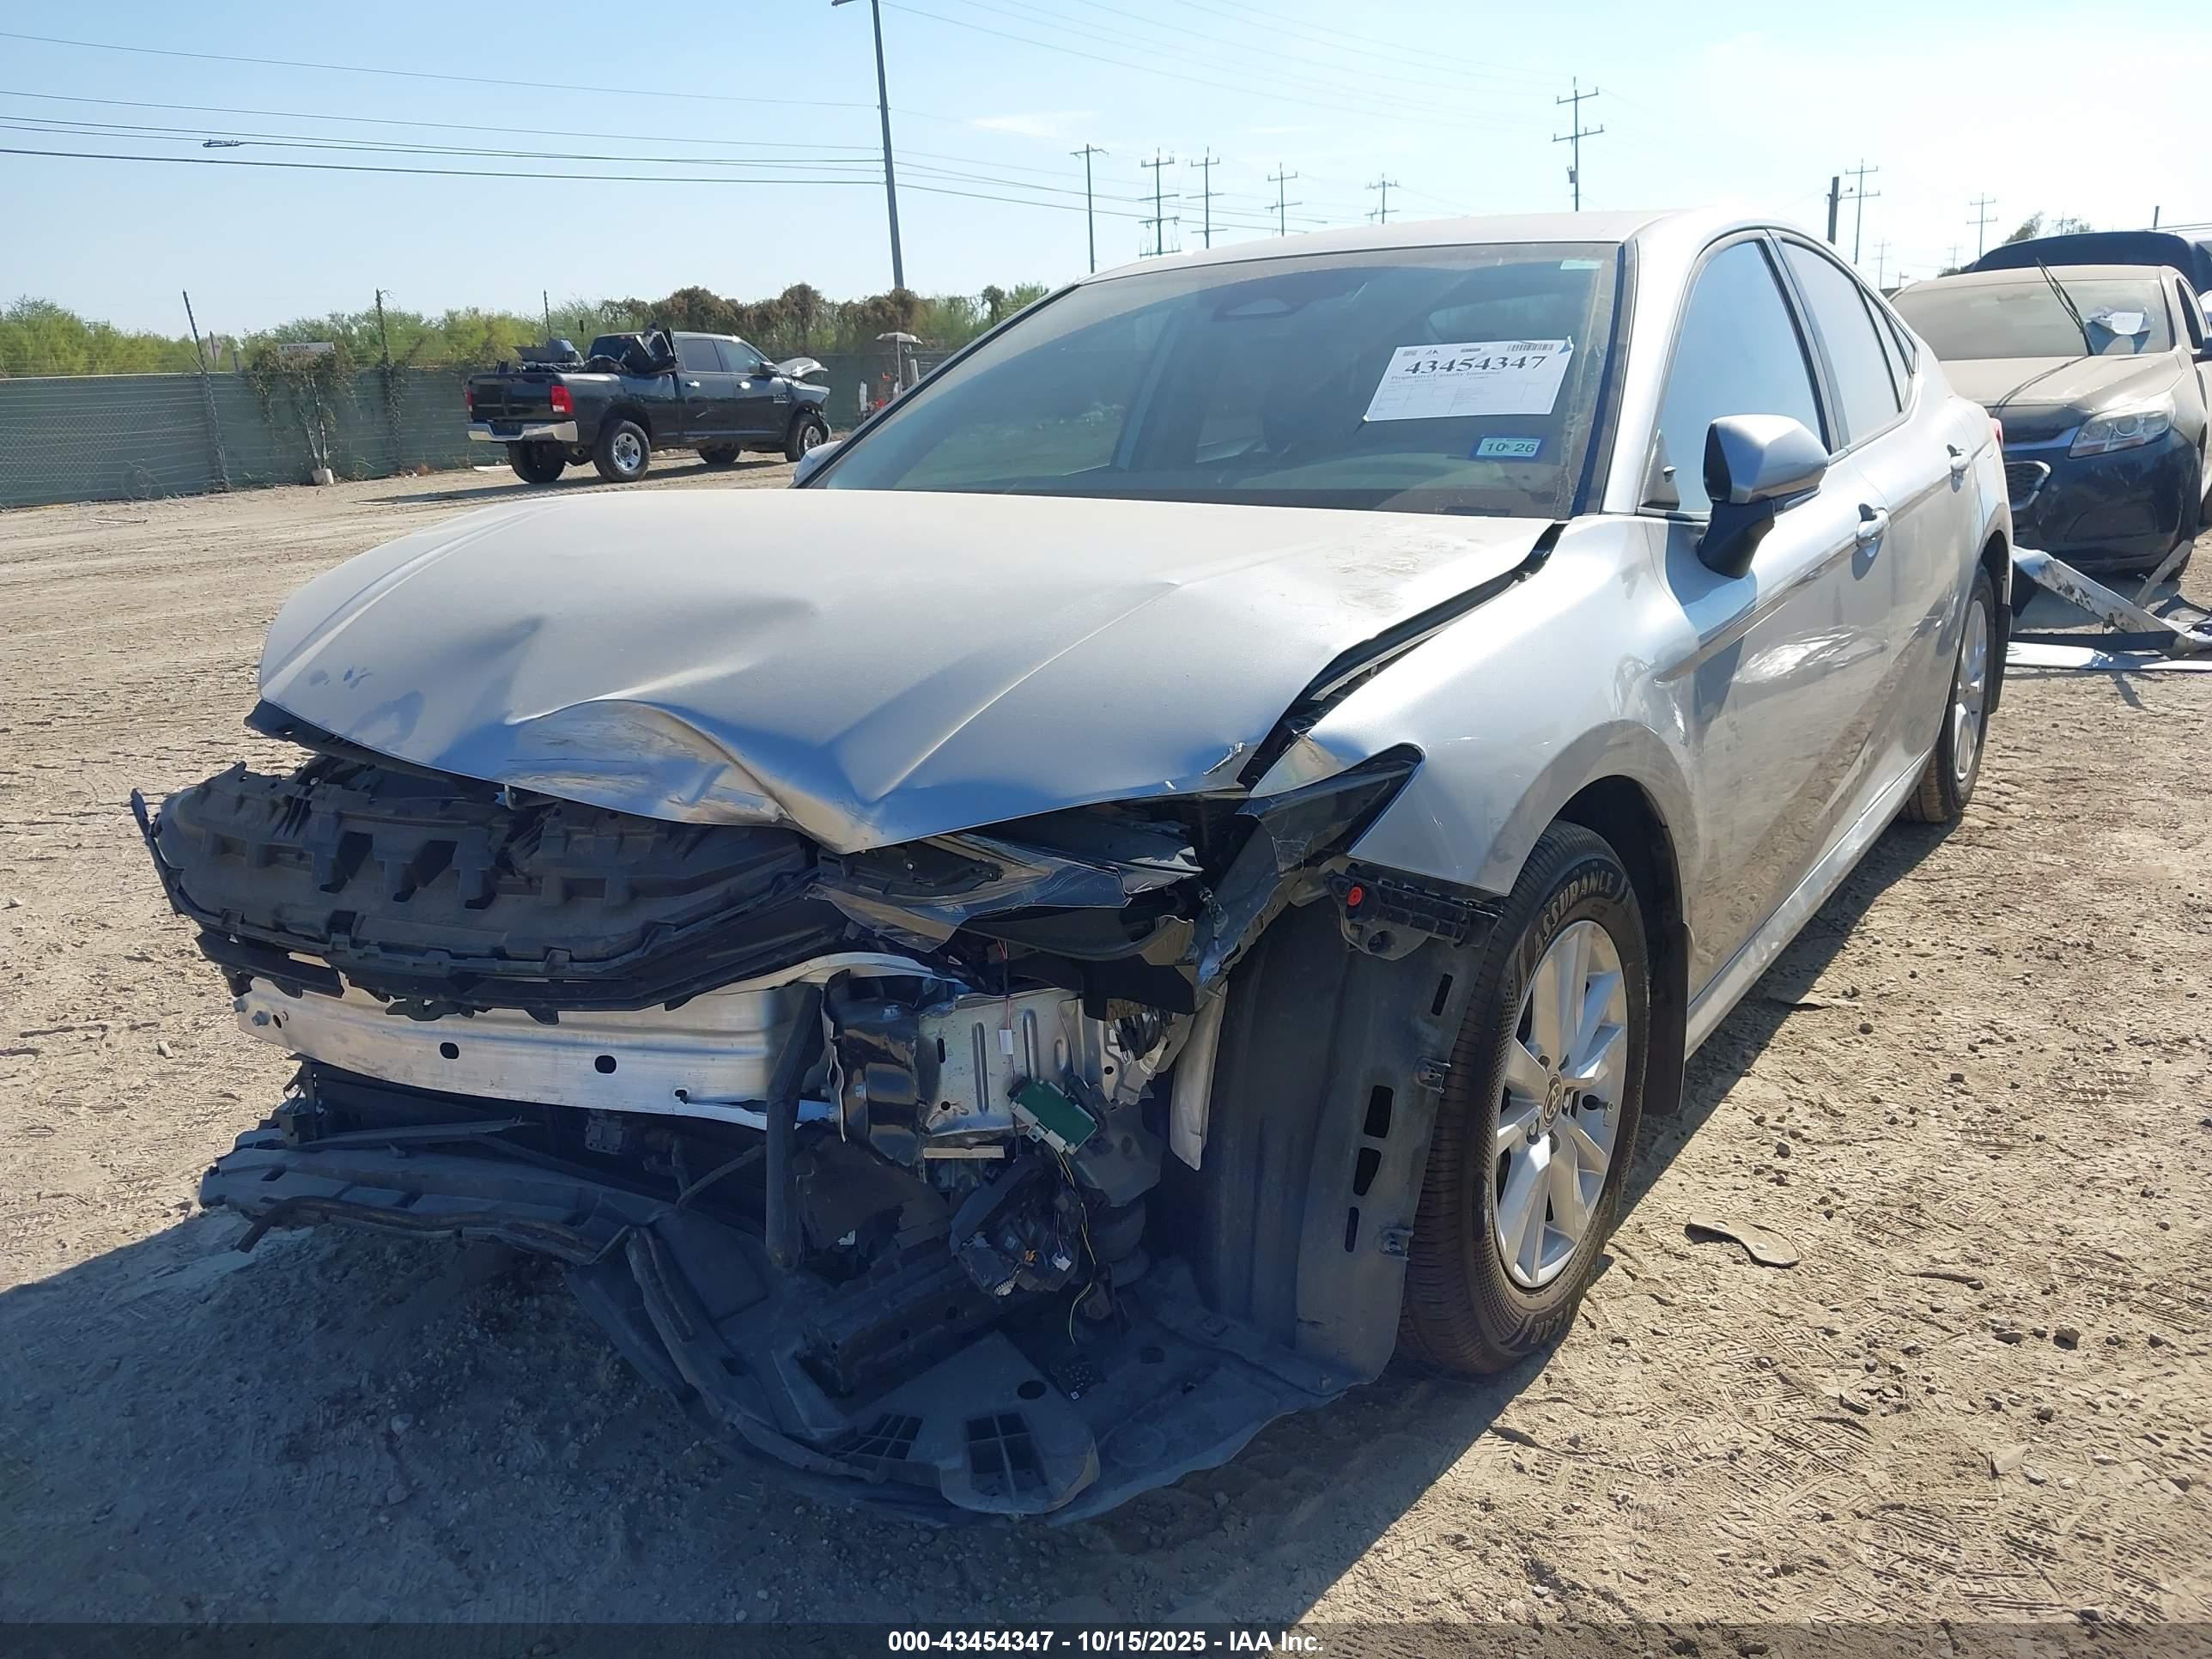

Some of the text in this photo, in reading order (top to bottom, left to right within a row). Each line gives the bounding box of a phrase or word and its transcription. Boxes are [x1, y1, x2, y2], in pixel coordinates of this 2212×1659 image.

[1405, 356, 1547, 374] 43454347
[1486, 442, 1536, 453] 10 26
[1533, 869, 1615, 963] ASSURANCE
